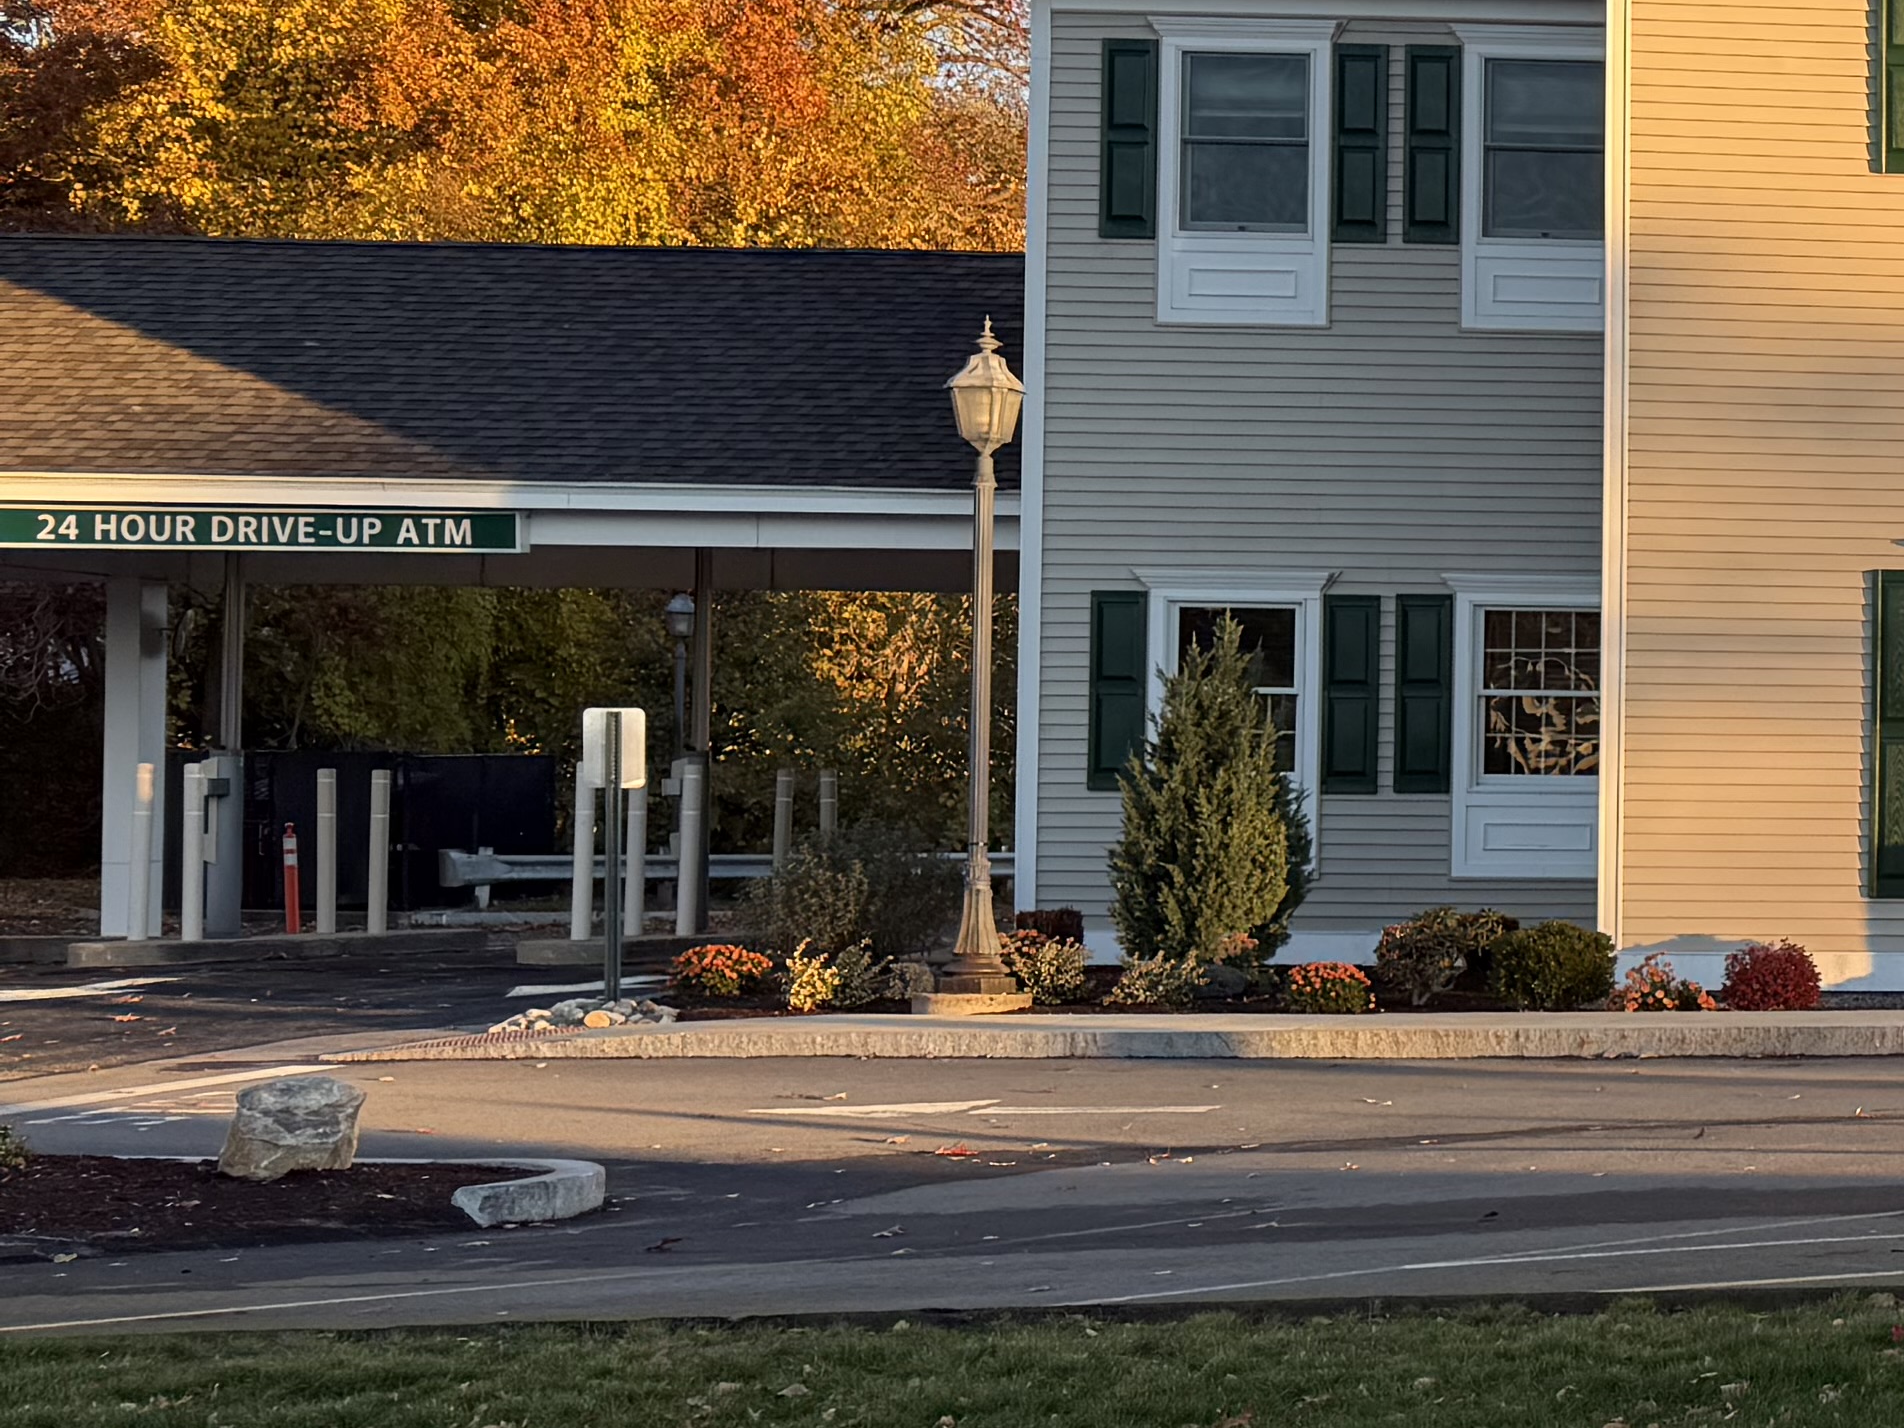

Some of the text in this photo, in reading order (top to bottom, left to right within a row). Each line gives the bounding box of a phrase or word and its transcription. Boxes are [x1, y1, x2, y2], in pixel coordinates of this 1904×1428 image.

[35, 513, 472, 546] 24 HOUR DRIVE-UP ATM
